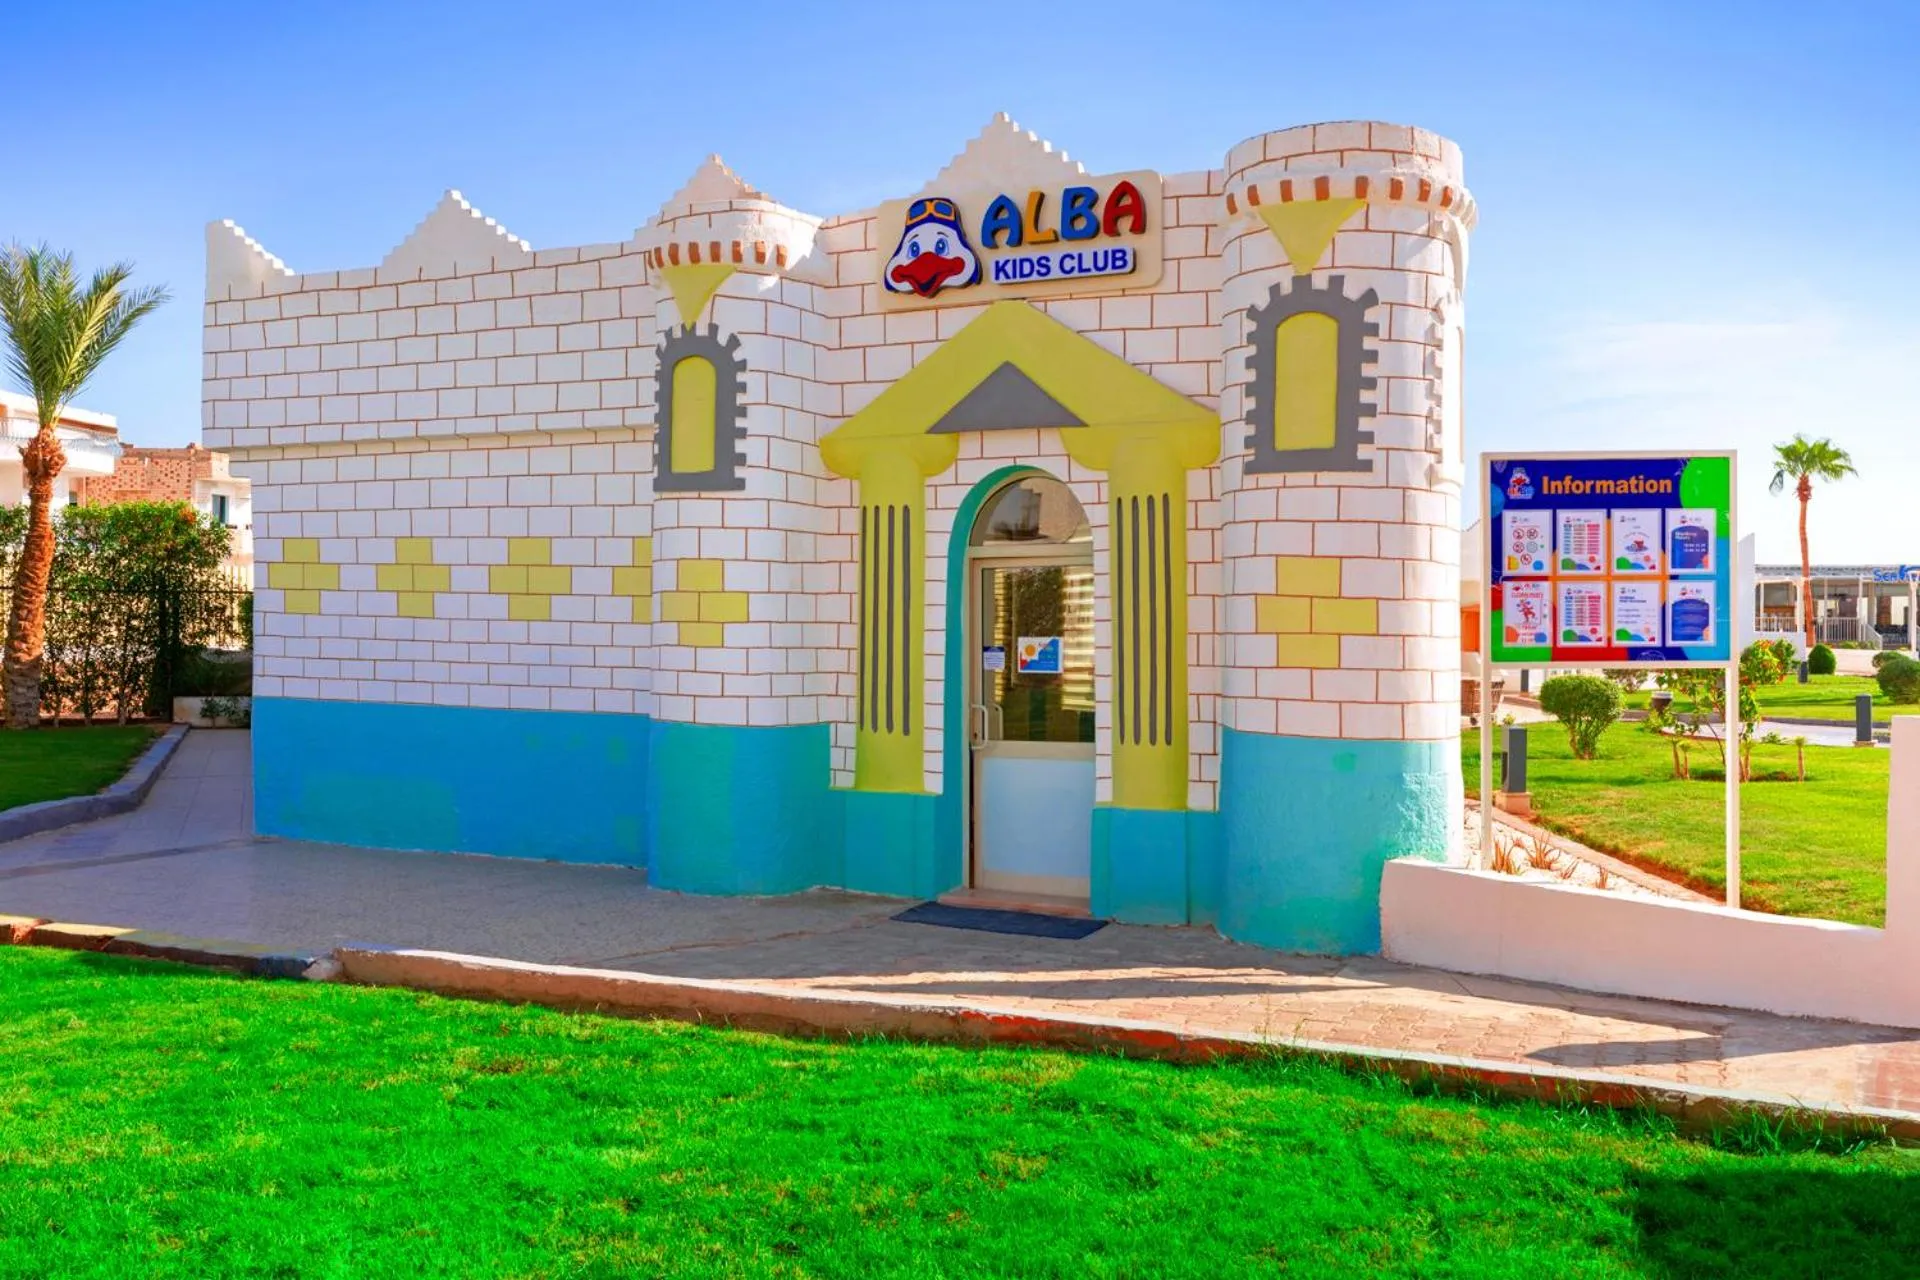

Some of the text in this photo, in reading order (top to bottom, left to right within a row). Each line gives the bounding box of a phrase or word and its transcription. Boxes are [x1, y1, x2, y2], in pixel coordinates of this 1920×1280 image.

[981, 180, 1146, 249] ALBA
[994, 248, 1128, 281] KIDS CLUB
[1542, 475, 1673, 494] Information
